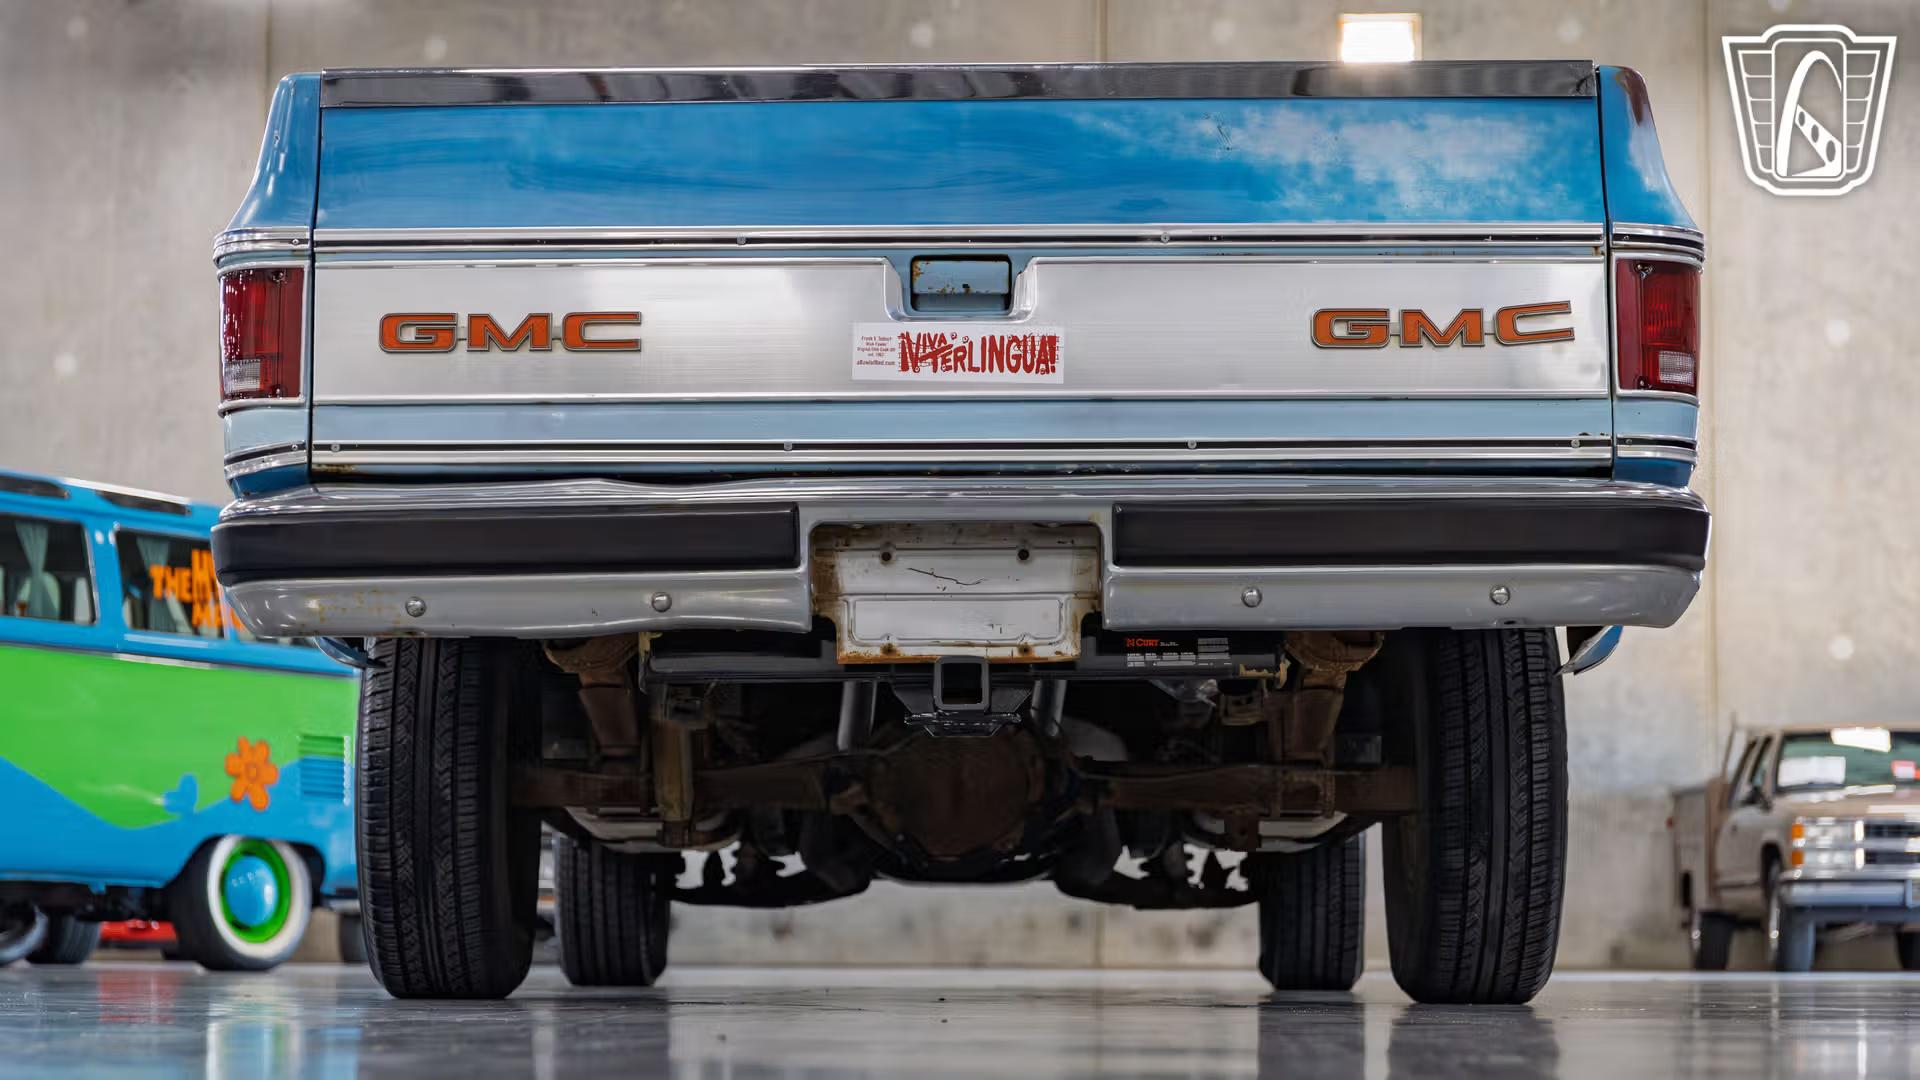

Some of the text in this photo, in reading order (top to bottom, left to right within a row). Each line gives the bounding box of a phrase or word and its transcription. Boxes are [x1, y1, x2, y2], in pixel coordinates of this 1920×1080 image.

[379, 312, 642, 353] GMC
[1311, 300, 1576, 348] GMC
[918, 333, 1057, 375] TERLINGUA!
[149, 564, 192, 602] THE
